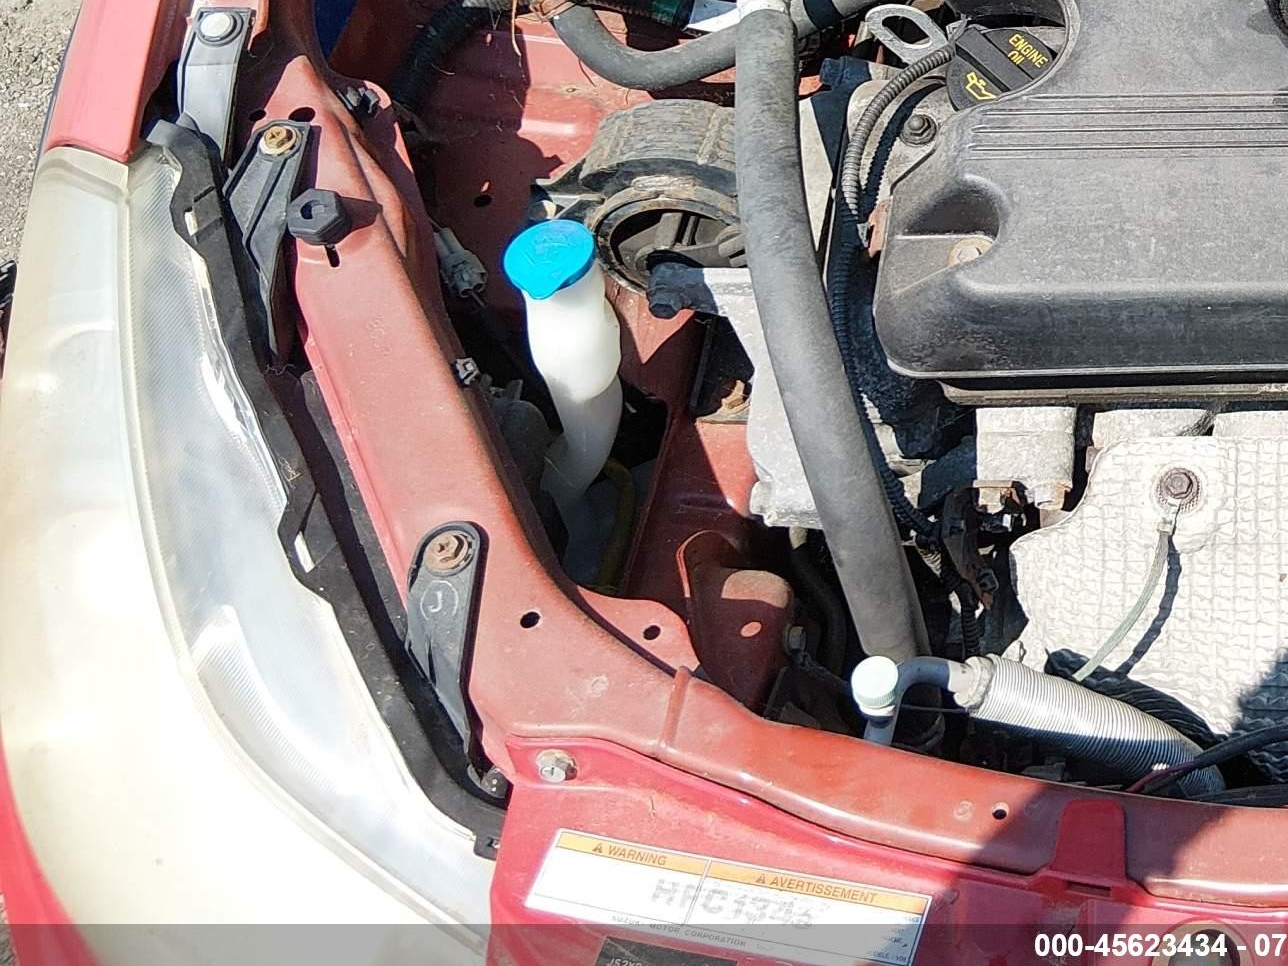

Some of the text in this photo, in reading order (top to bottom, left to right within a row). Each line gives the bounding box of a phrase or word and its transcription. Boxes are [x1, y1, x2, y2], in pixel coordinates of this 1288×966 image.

[1008, 33, 1049, 68] ENGINE
[607, 845, 668, 866] WARNING
[770, 875, 878, 903] AVERTISSEMENT
[649, 923, 681, 934] MOTOR
[684, 929, 746, 947] CORPORATION
